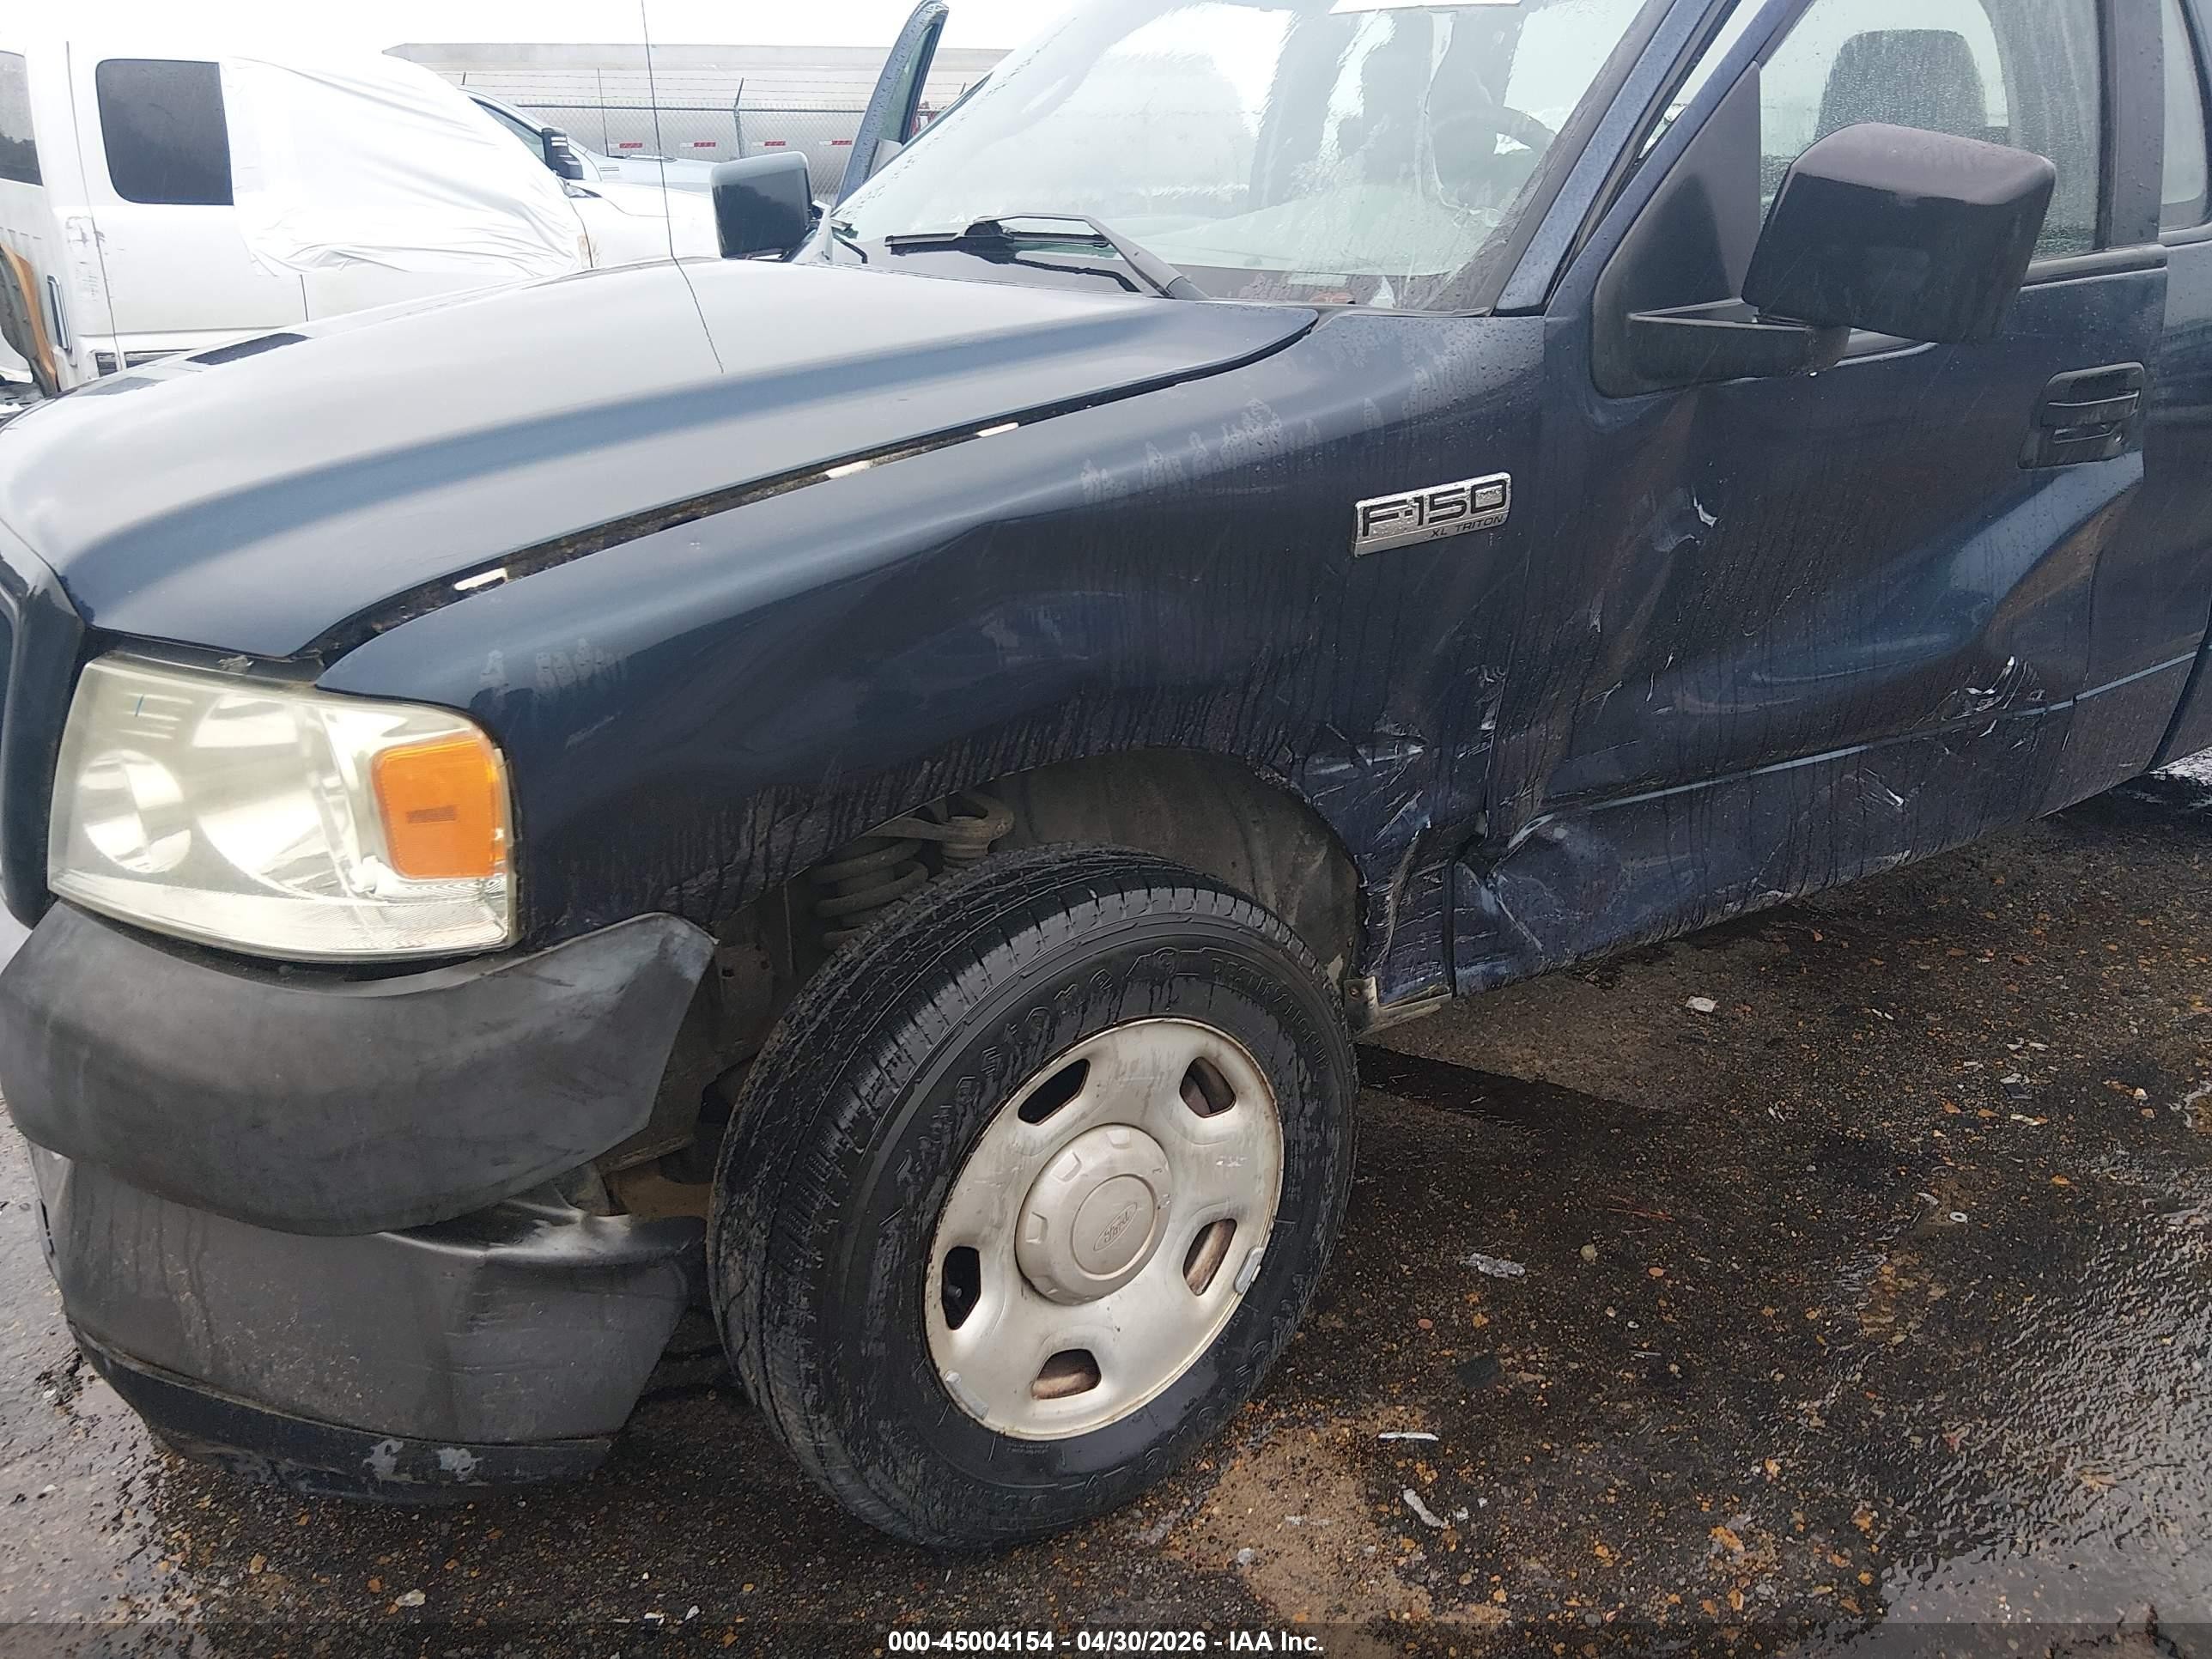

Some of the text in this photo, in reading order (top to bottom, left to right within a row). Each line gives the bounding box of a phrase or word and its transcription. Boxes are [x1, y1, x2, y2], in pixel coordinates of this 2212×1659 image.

[1363, 478, 1507, 538] F-150
[1431, 515, 1503, 538] XL TRITON
